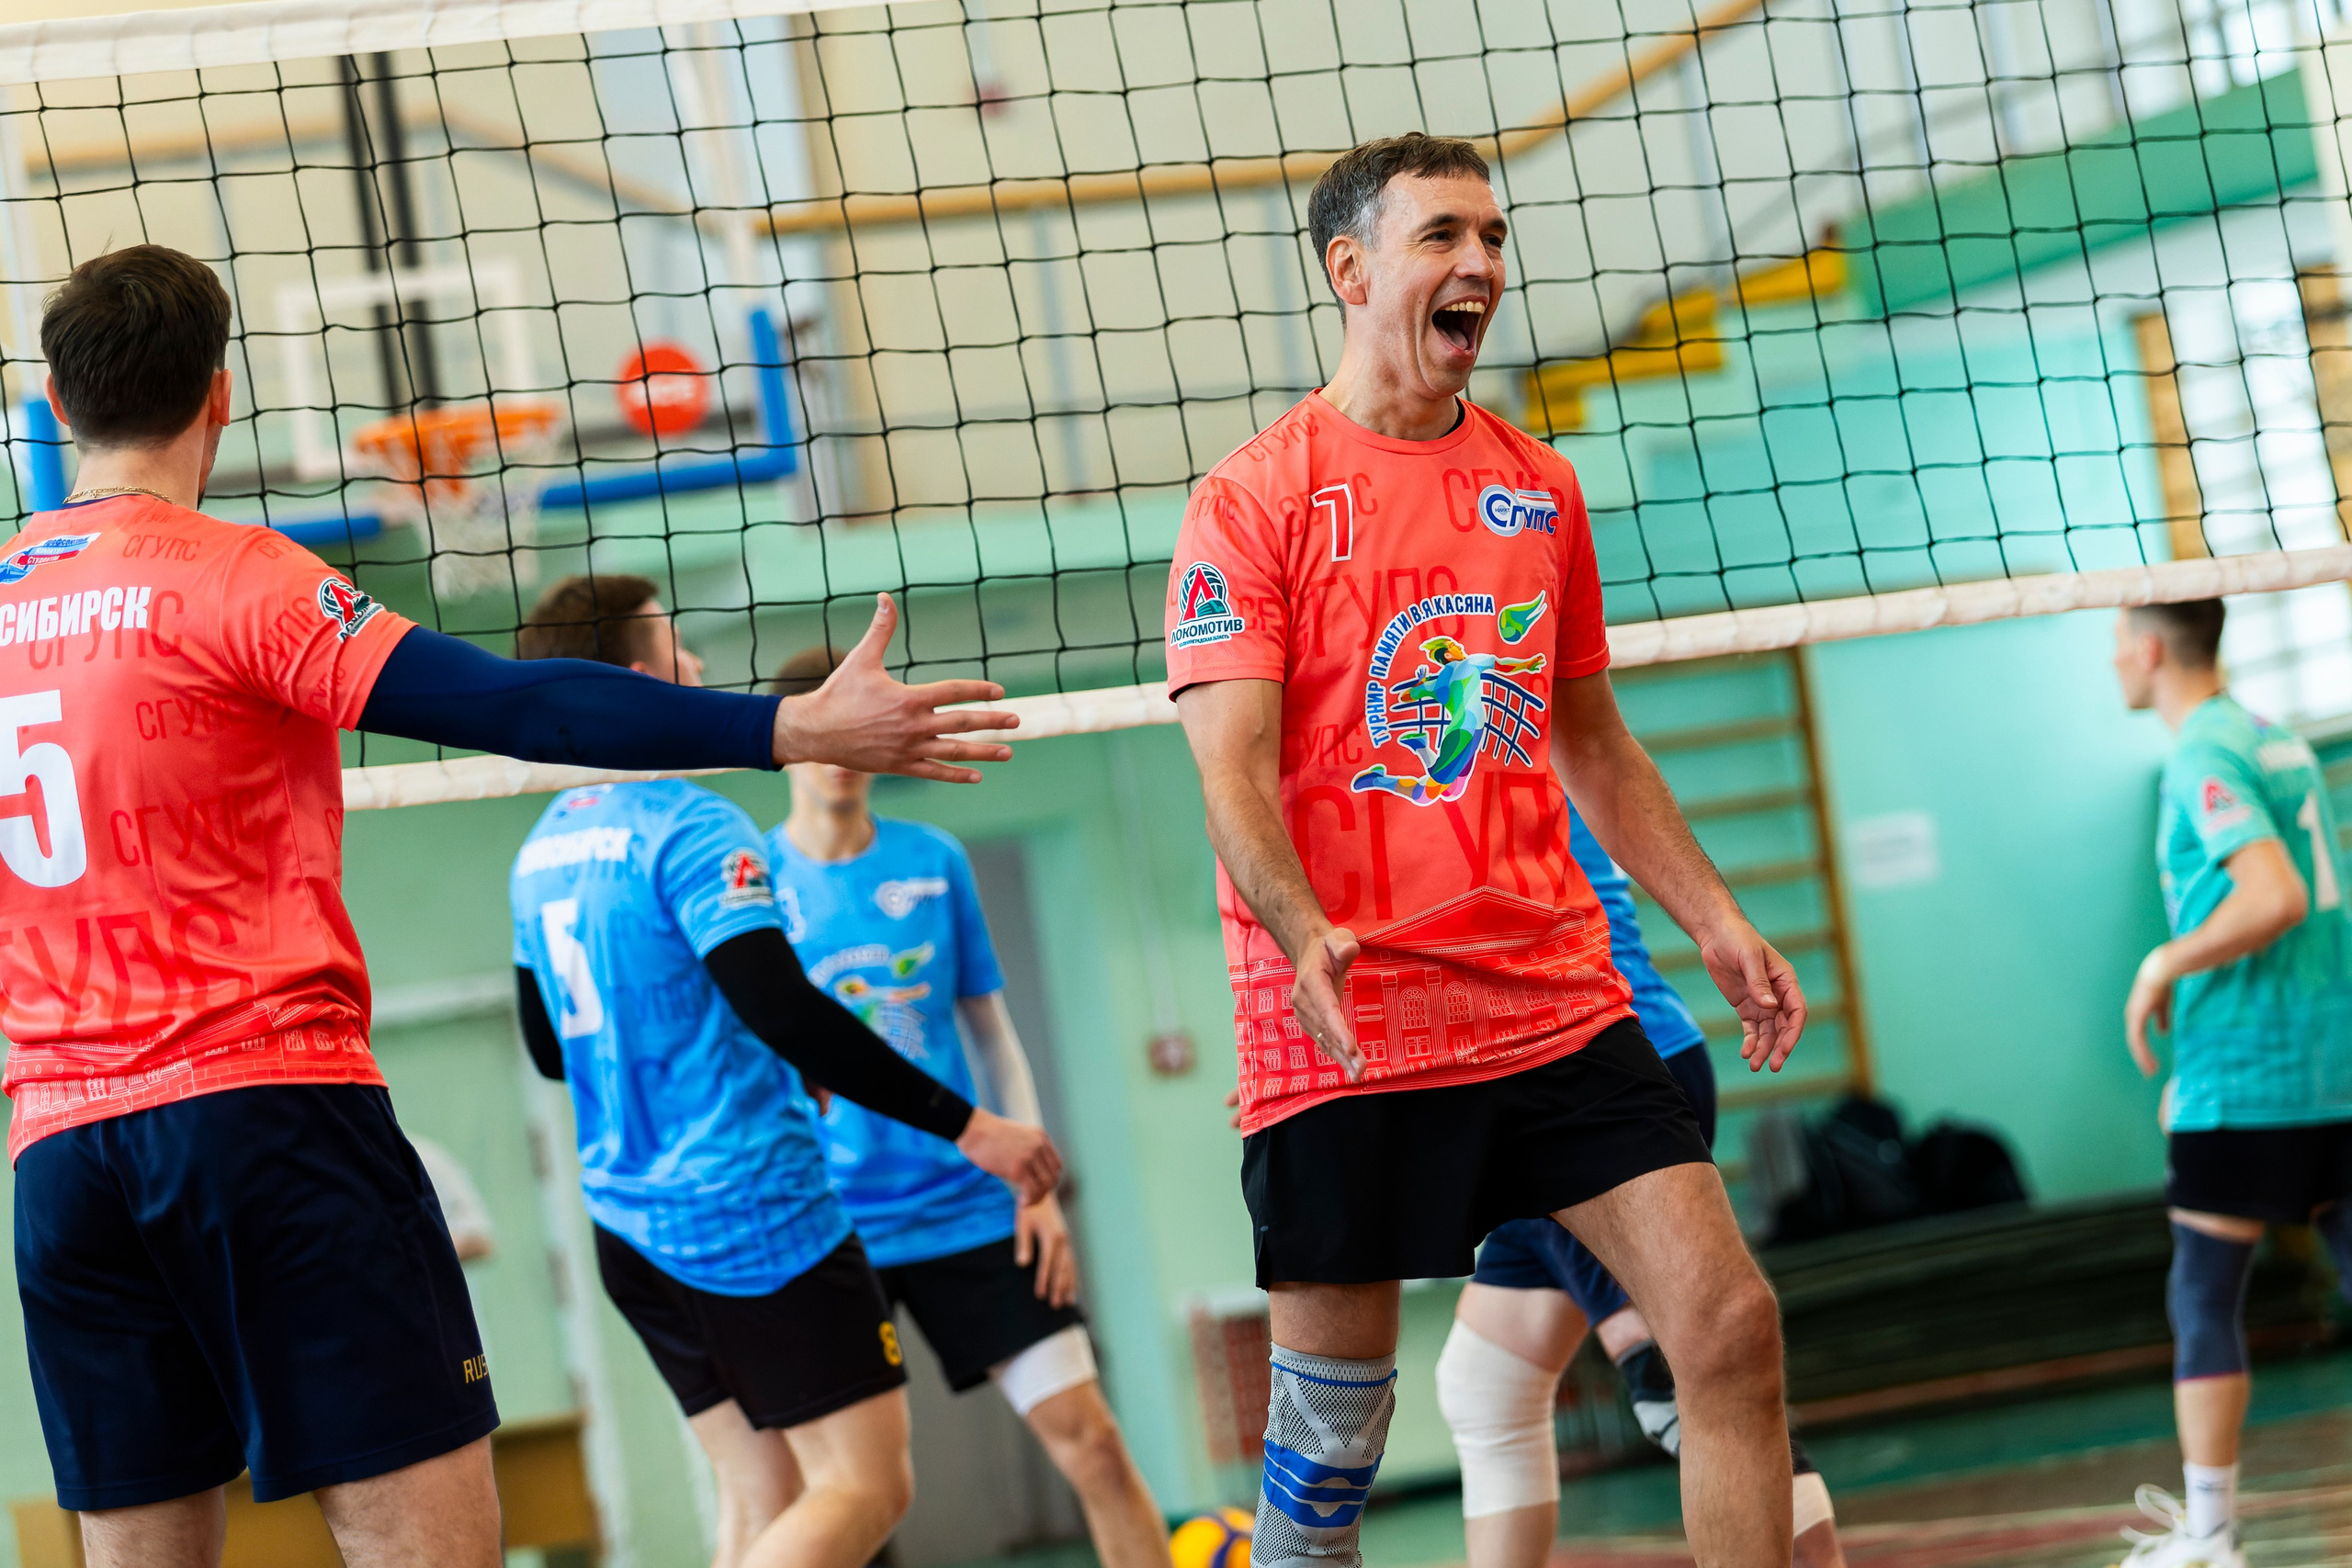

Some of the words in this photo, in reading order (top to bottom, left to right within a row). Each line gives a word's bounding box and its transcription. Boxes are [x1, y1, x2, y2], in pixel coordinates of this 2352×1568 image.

[1244, 412, 1319, 463] СГУПС
[1486, 493, 1559, 535] СГУПС
[122, 534, 201, 561] СГУПС
[0, 586, 152, 647] СИБИРСК
[1170, 619, 1243, 644] ЛОКОМОТИВ
[1409, 595, 1495, 625] В.Я.КАСЯНА
[1371, 613, 1413, 677] ПАМЯТИ
[1366, 682, 1390, 747] ТУРНИР
[0, 689, 87, 888] 5
